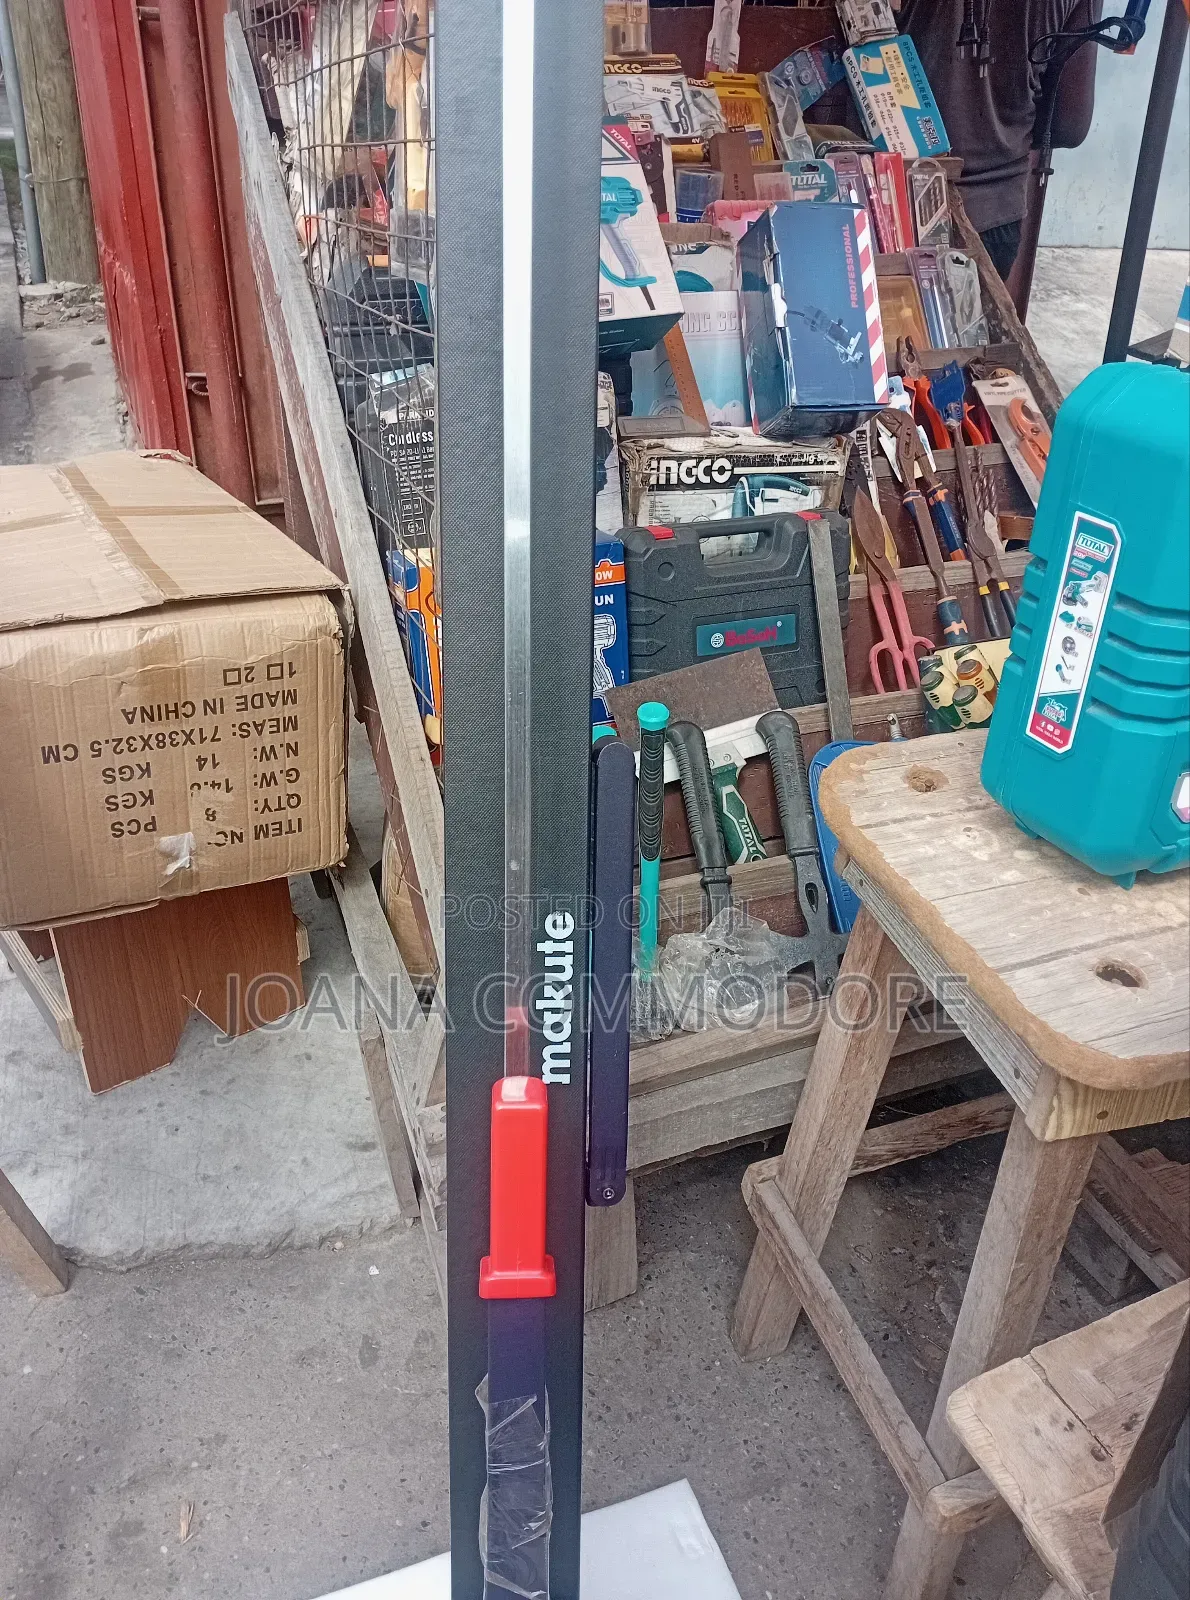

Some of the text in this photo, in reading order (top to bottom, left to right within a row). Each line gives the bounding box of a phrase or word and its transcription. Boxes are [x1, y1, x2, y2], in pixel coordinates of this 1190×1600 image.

[610, 128, 632, 151] TOTAL
[790, 173, 828, 185] TOTAL
[842, 223, 859, 309] PROFESSIONAL
[649, 458, 733, 485] INGCO
[1080, 536, 1107, 554] TOTAL
[120, 688, 298, 725] MADE IN CHINA
[41, 715, 299, 765] MEAS: 71X38X32.5 CM
[101, 741, 300, 785] N.W: 14 KGS
[253, 768, 300, 789] G.W:
[104, 789, 155, 813] KGS
[253, 793, 302, 814] QTY:
[110, 815, 157, 839] PCS
[253, 817, 303, 841] ITEM
[738, 817, 757, 854] TOTAL
[535, 909, 575, 1085] makute
